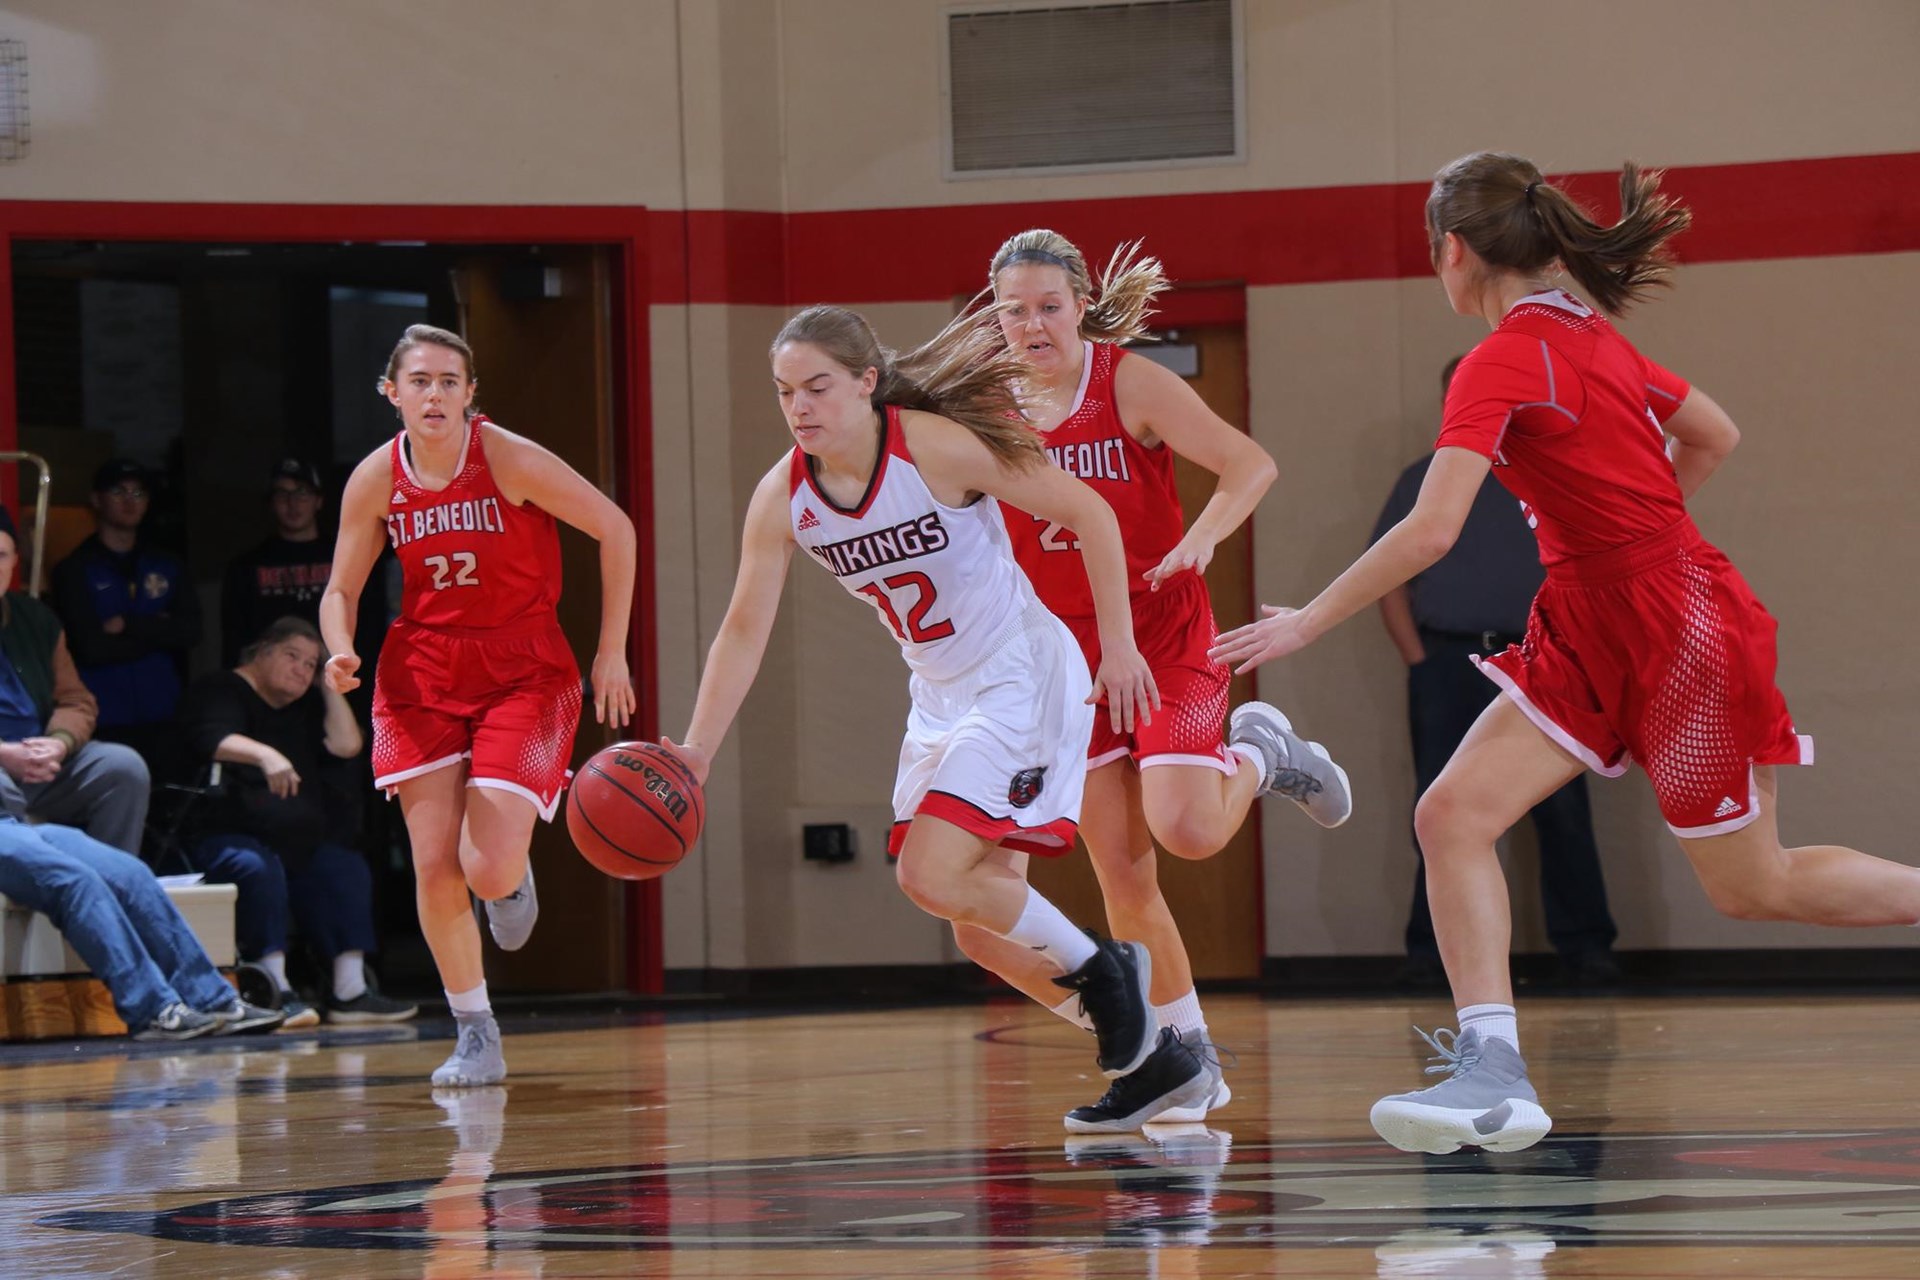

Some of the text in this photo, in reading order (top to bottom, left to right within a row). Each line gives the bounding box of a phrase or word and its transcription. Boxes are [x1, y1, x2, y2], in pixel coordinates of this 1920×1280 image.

[1045, 437, 1130, 482] NEDICT
[387, 496, 505, 550] ST. BENEDICT
[798, 519, 821, 531] adidas
[811, 511, 950, 577] VIKINGS
[1032, 514, 1081, 553] 2
[424, 551, 480, 591] 22
[855, 570, 956, 644] 12
[614, 753, 689, 824] Wilson
[1714, 804, 1742, 818] adidas
